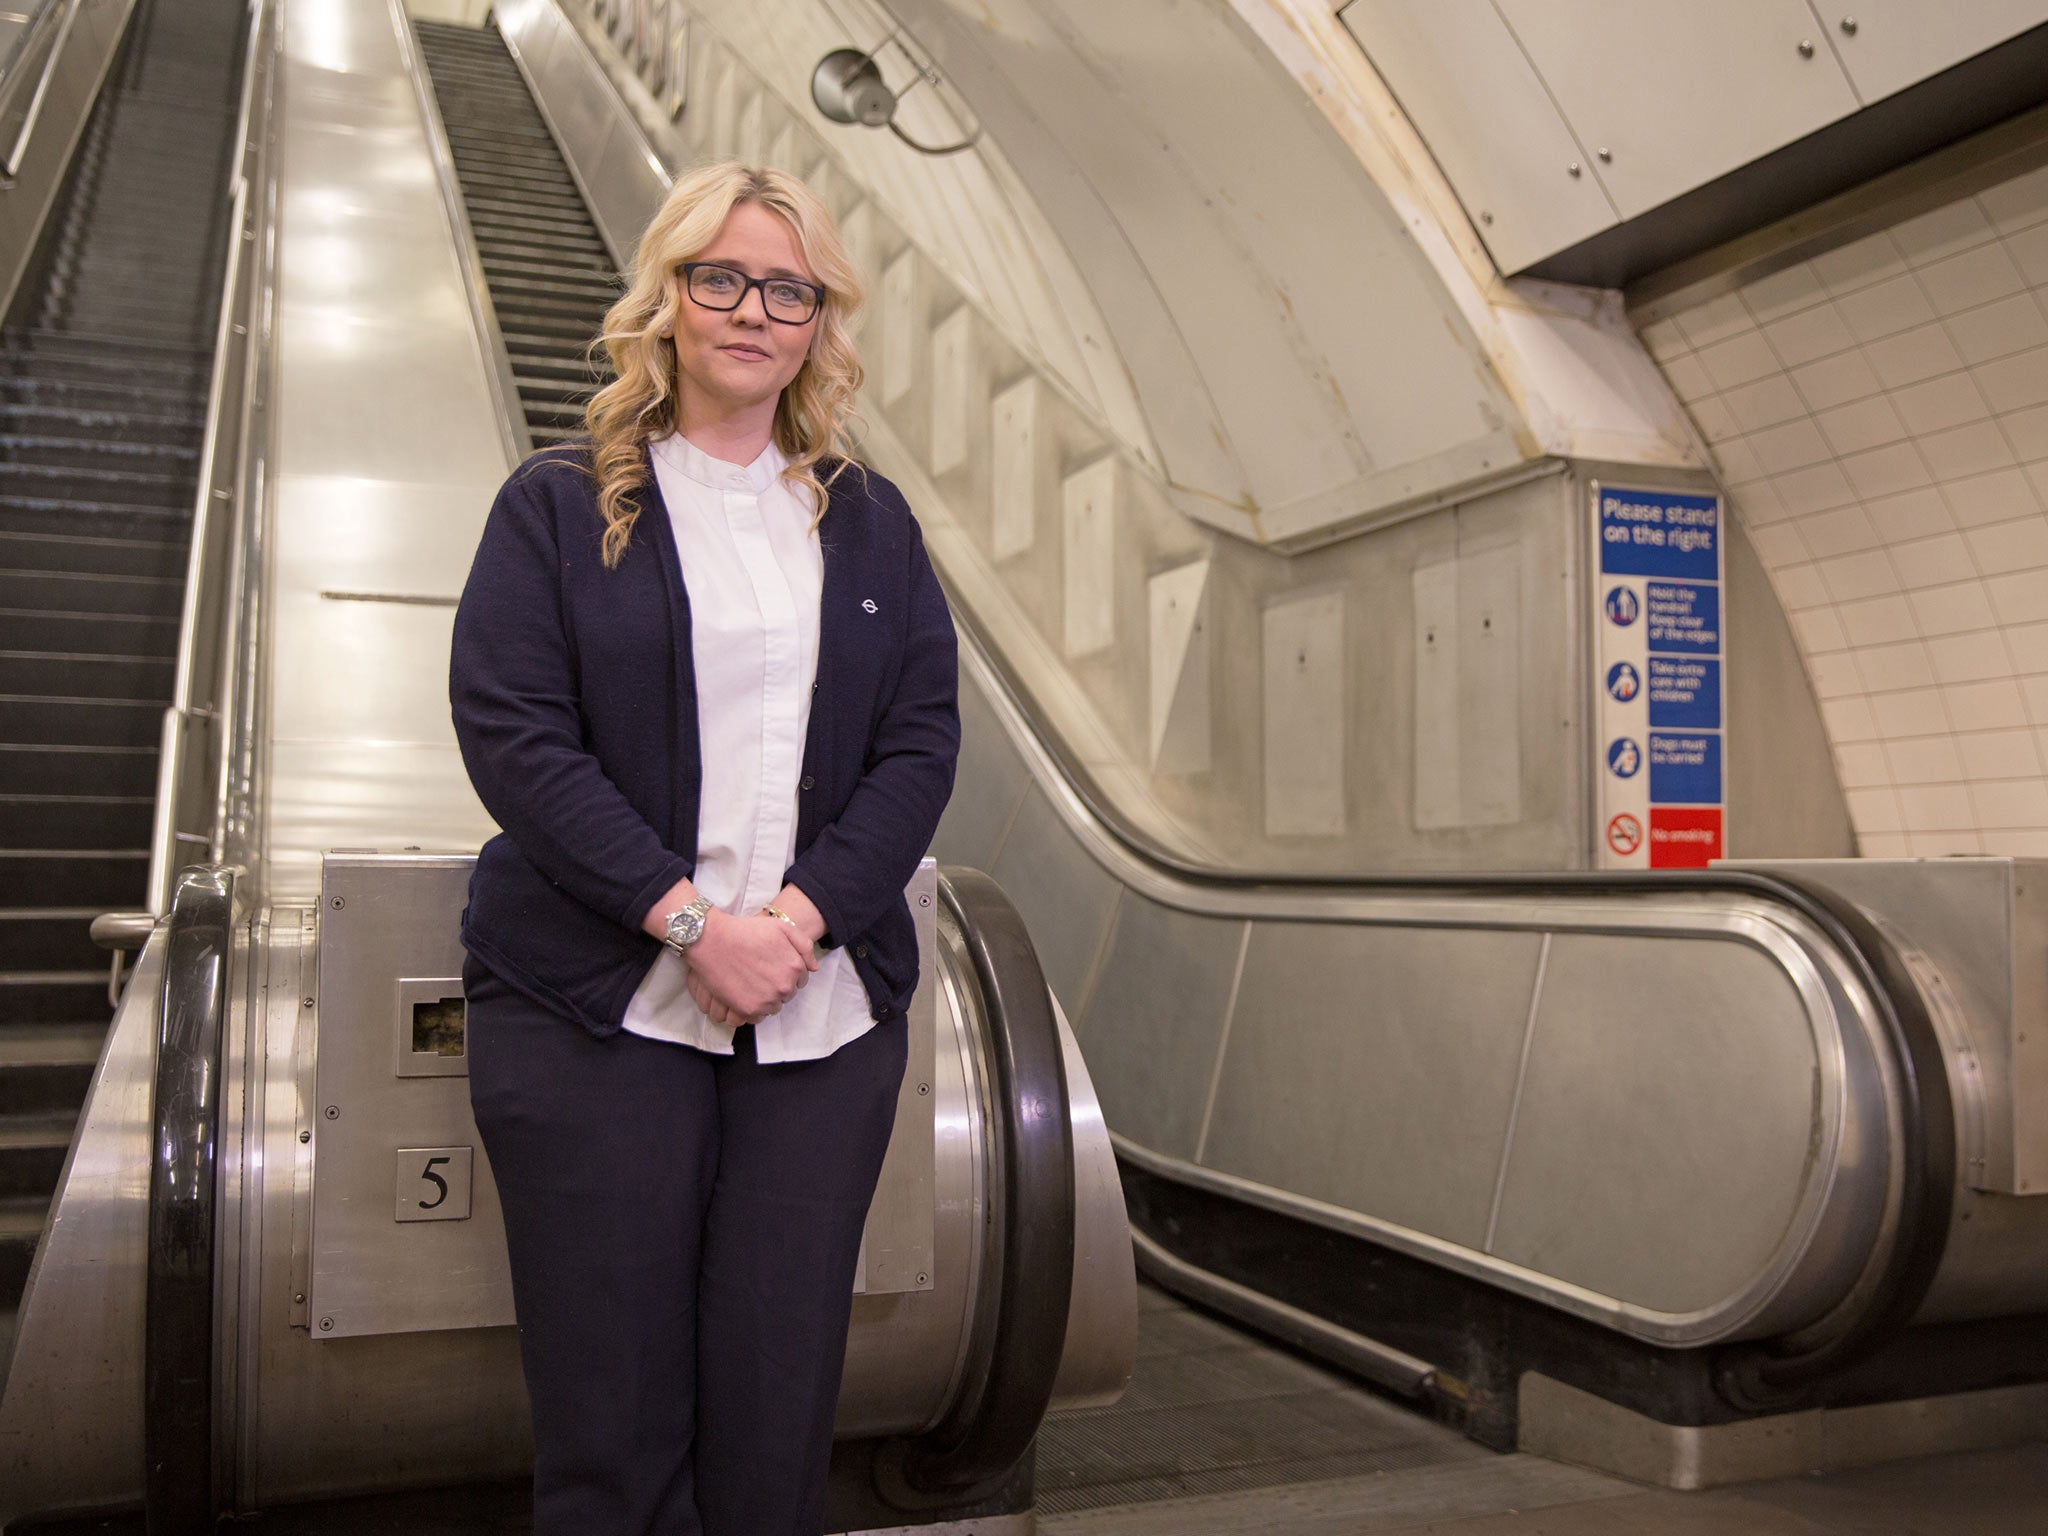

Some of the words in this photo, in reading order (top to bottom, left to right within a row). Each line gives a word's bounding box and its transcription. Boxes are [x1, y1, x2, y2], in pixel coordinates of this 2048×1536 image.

[1603, 498, 1663, 522] Please
[1665, 506, 1715, 526] stand
[1604, 525, 1630, 543] on
[1632, 524, 1666, 546] the
[1667, 527, 1712, 552] right
[1650, 627, 1663, 639] of
[1664, 628, 1684, 640] the
[1685, 630, 1717, 644] edges
[1651, 661, 1676, 675] Take
[1677, 664, 1706, 677] extra
[1651, 676, 1675, 688] care
[1676, 677, 1701, 690] with
[1652, 828, 1669, 842] No
[1670, 829, 1714, 845] smoking
[419, 1157, 451, 1210] 5
